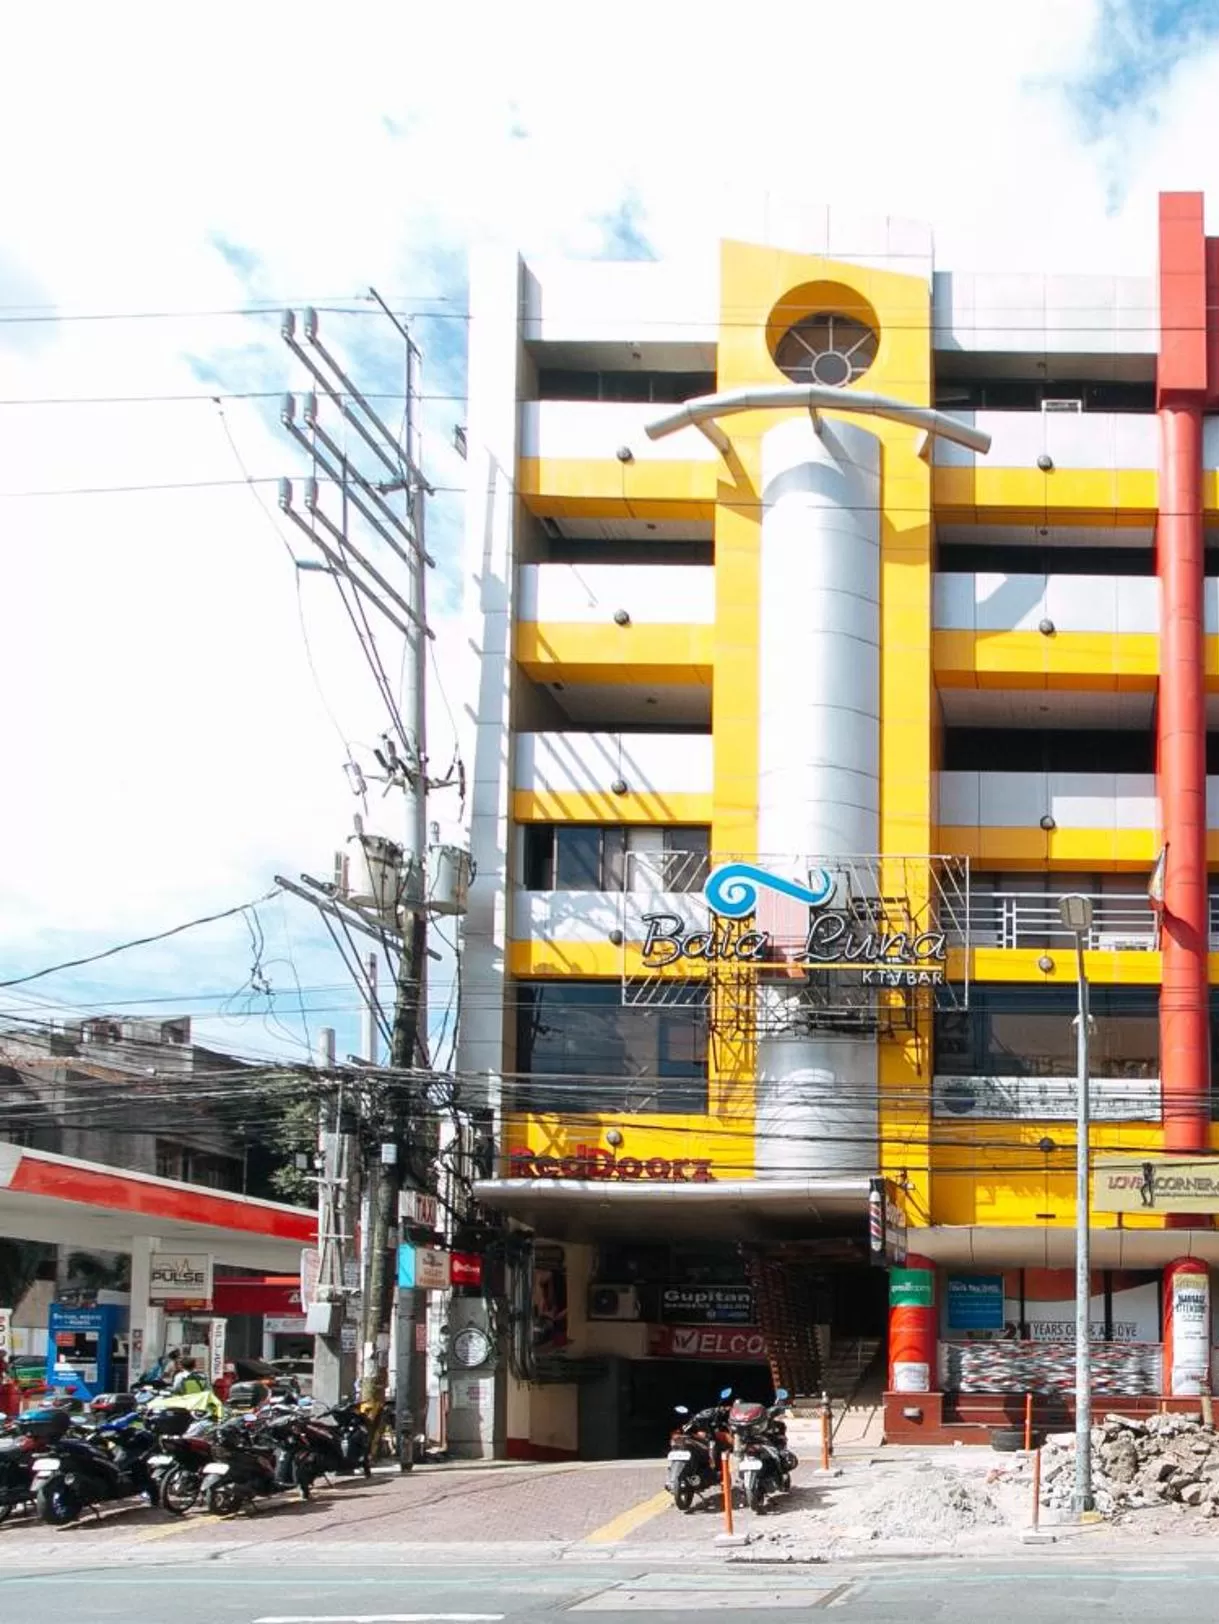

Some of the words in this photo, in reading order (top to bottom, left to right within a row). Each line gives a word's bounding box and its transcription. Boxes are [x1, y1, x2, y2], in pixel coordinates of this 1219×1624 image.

[641, 912, 770, 968] Baia
[795, 912, 948, 961] Luna
[906, 971, 942, 986] BAR
[152, 1272, 204, 1282] PULSE
[663, 1290, 751, 1304] Gupitan
[1033, 1324, 1063, 1336] YEARS
